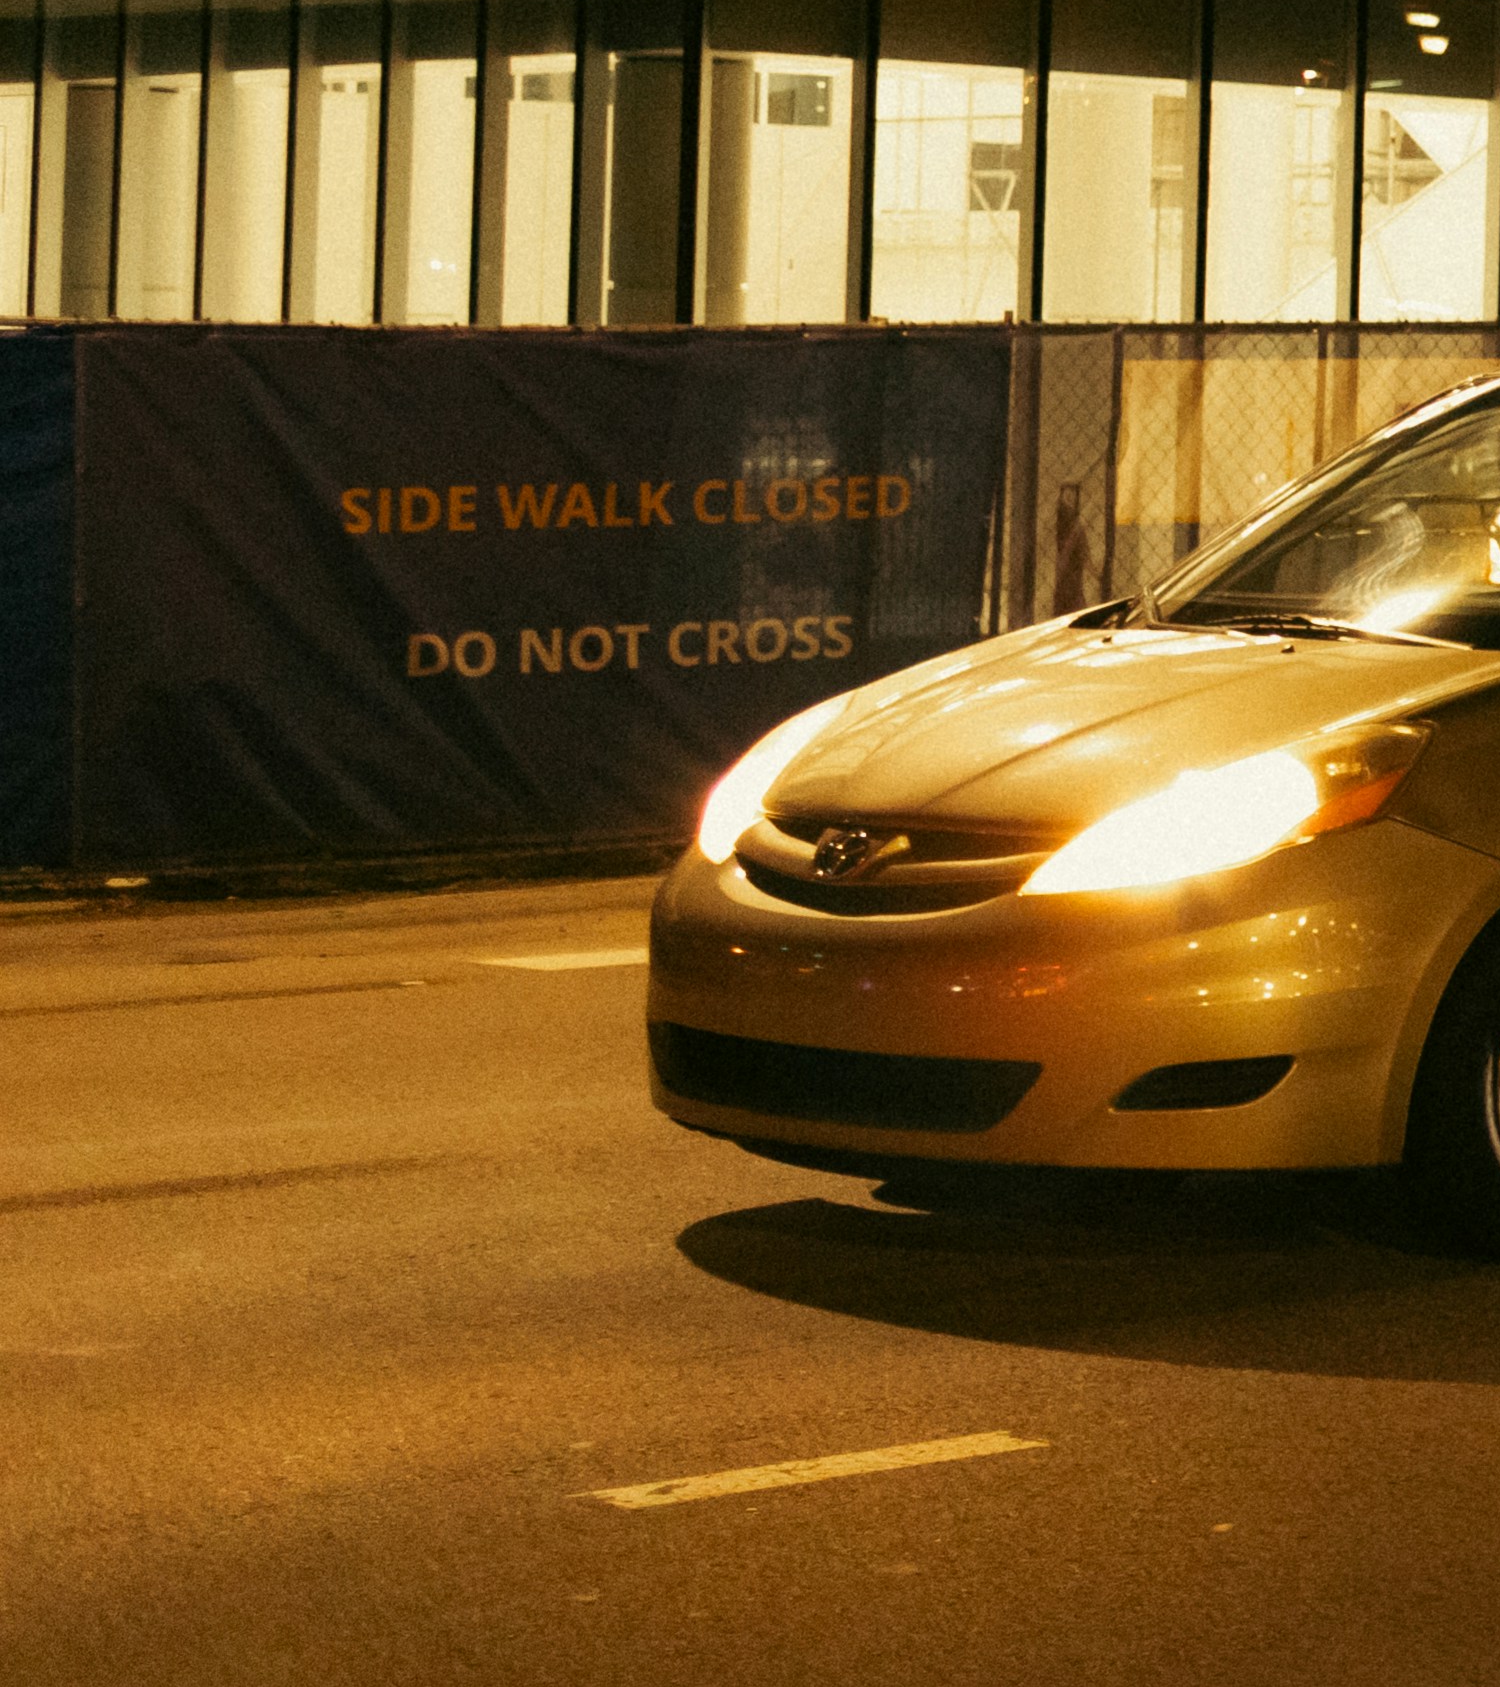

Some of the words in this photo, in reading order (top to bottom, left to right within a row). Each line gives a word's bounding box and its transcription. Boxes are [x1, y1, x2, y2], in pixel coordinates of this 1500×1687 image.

[340, 485, 478, 535] SIDE
[499, 480, 675, 530] WALK
[693, 475, 912, 526] CLOSED
[406, 631, 498, 679] DO
[519, 623, 650, 673] NOT
[668, 615, 854, 667] CROSS
